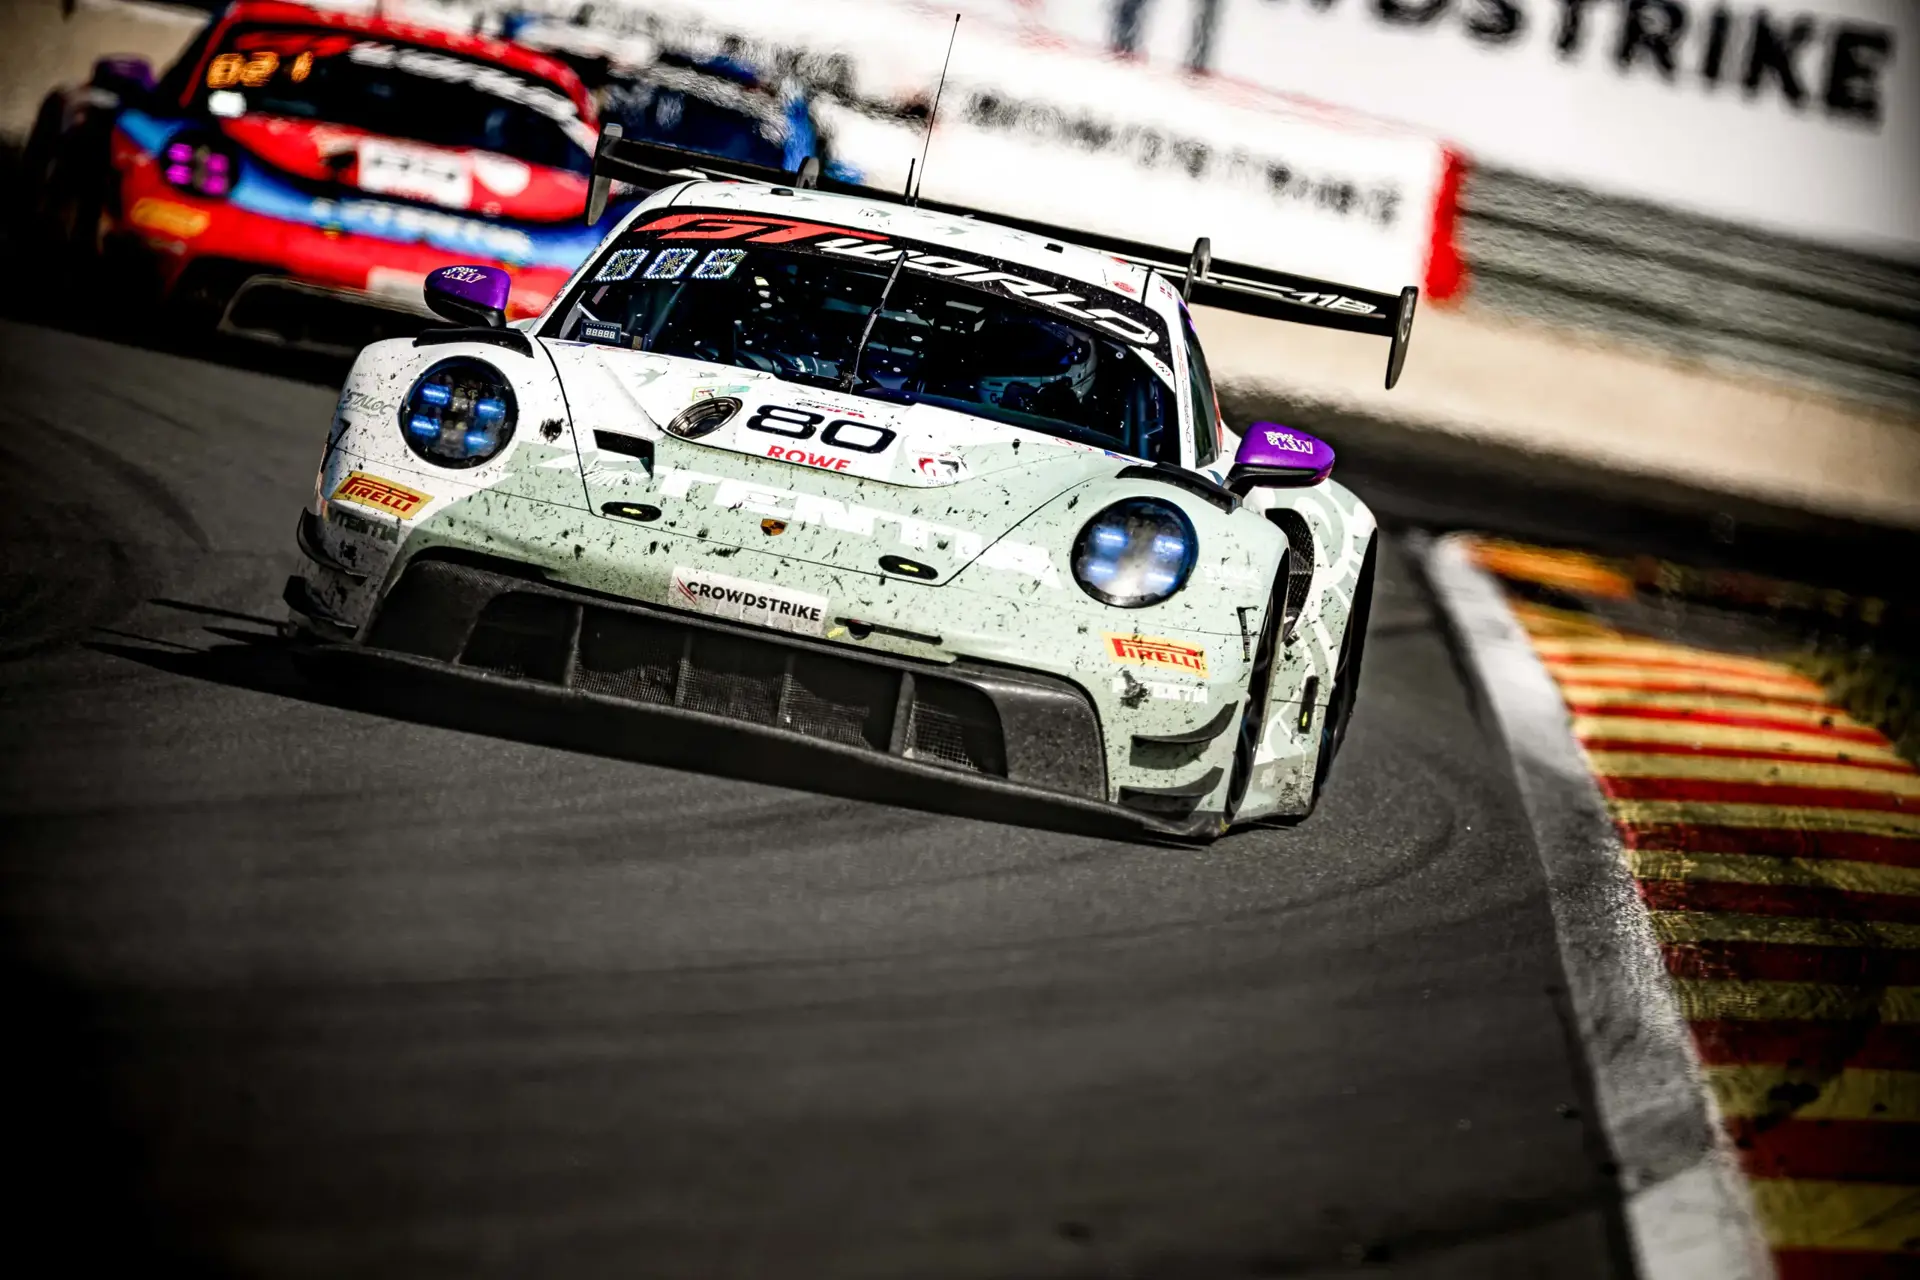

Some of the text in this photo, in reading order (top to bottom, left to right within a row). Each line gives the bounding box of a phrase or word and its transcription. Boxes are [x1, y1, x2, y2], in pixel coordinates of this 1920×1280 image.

[746, 404, 898, 455] 80
[766, 444, 852, 471] ROWE
[339, 475, 421, 513] PIRELLI
[686, 580, 822, 622] CROWDSTRIKE
[1110, 637, 1204, 671] PIRELLI
